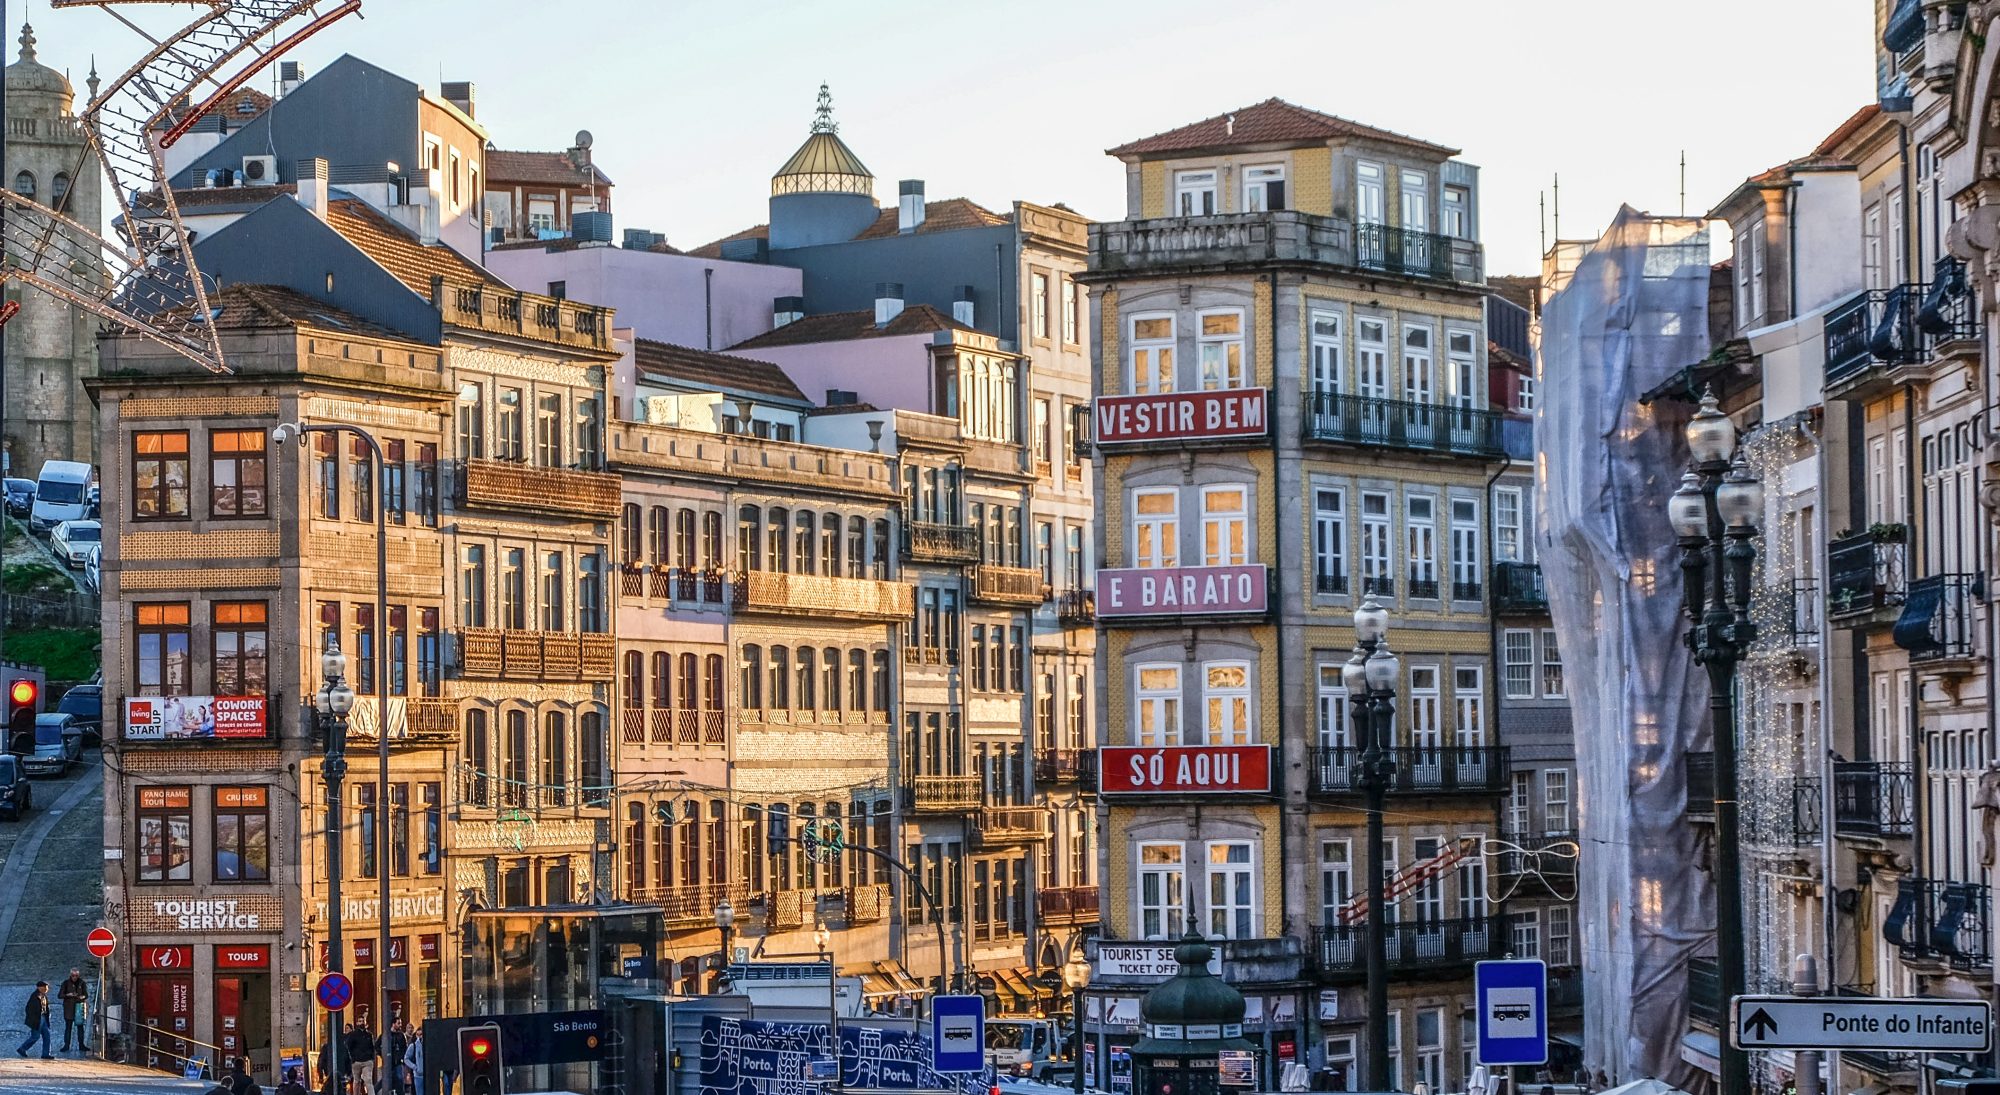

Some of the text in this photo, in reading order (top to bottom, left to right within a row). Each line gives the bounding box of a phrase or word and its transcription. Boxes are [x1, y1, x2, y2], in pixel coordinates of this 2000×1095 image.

[1100, 397, 1262, 435] VESTIR BEM
[1110, 573, 1252, 608] E BARATO
[216, 700, 262, 710] COWORK
[131, 707, 150, 718] living
[153, 709, 161, 724] UP
[216, 711, 257, 721] SPACES
[129, 726, 161, 735] START
[1130, 749, 1240, 786] SÓ AQUI
[154, 901, 238, 915] TOURIST
[317, 899, 380, 922] TURIST
[178, 915, 259, 929] SERVICE
[228, 952, 259, 962] TOURS
[1102, 949, 1152, 961] TOURIST
[1119, 964, 1152, 974] TICKET
[553, 1022, 598, 1032] São Bento
[1120, 1016, 1139, 1025] travel
[1822, 1012, 1984, 1035] Ponte do Infante
[743, 1057, 774, 1072] Porto.
[883, 1067, 913, 1083] Porto.
